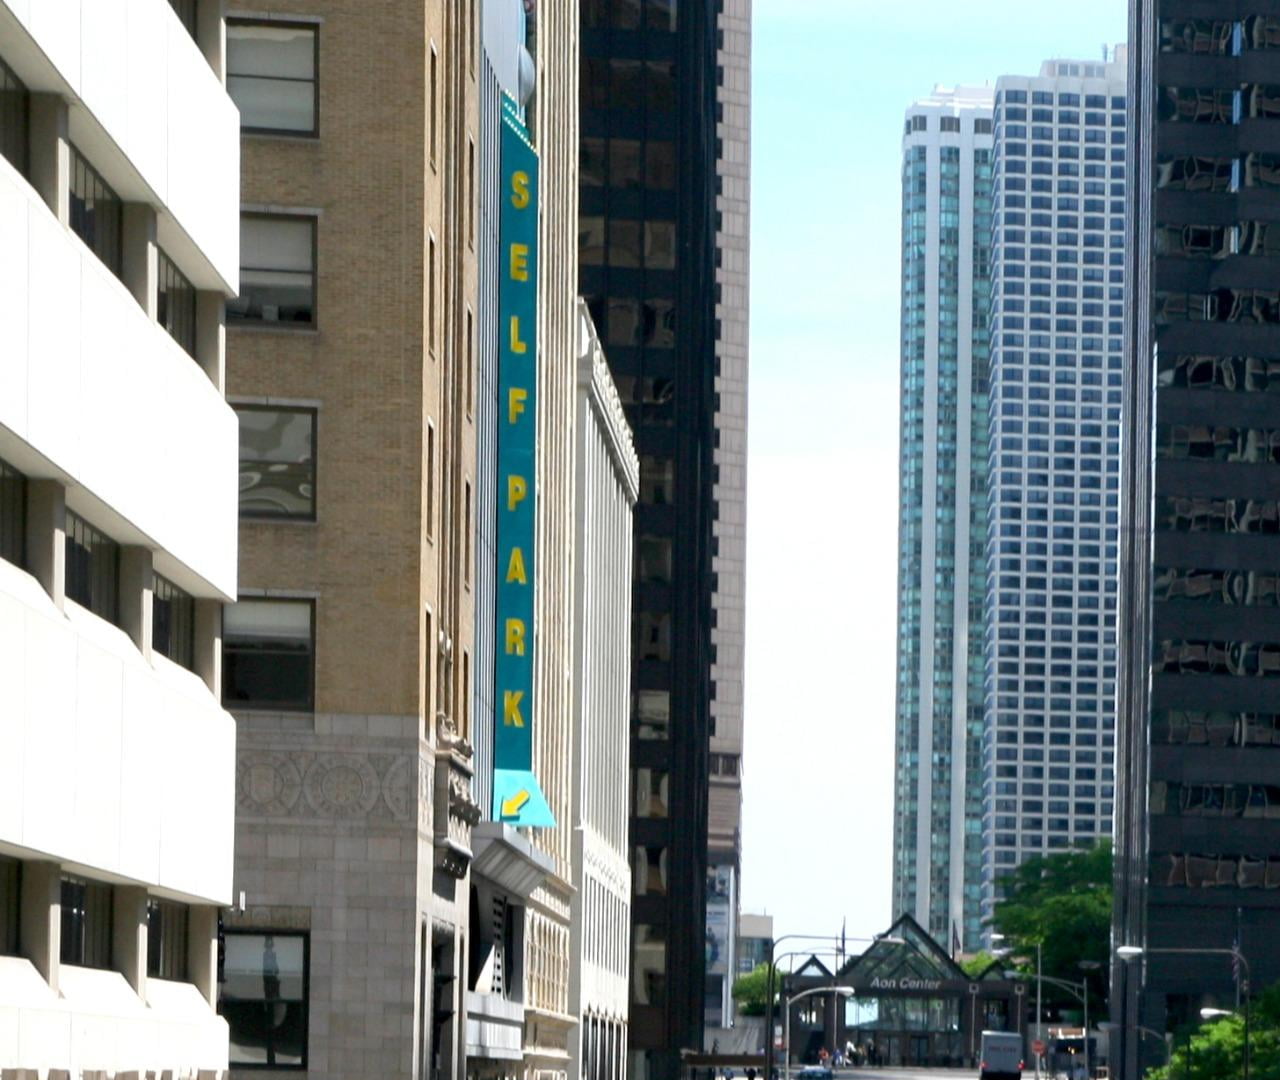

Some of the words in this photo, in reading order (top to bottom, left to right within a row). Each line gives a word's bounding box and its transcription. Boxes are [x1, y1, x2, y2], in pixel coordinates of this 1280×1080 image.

[508, 170, 529, 424] SELF
[504, 475, 527, 728] PARK
[870, 977, 896, 988] Aon
[899, 978, 941, 989] Center
